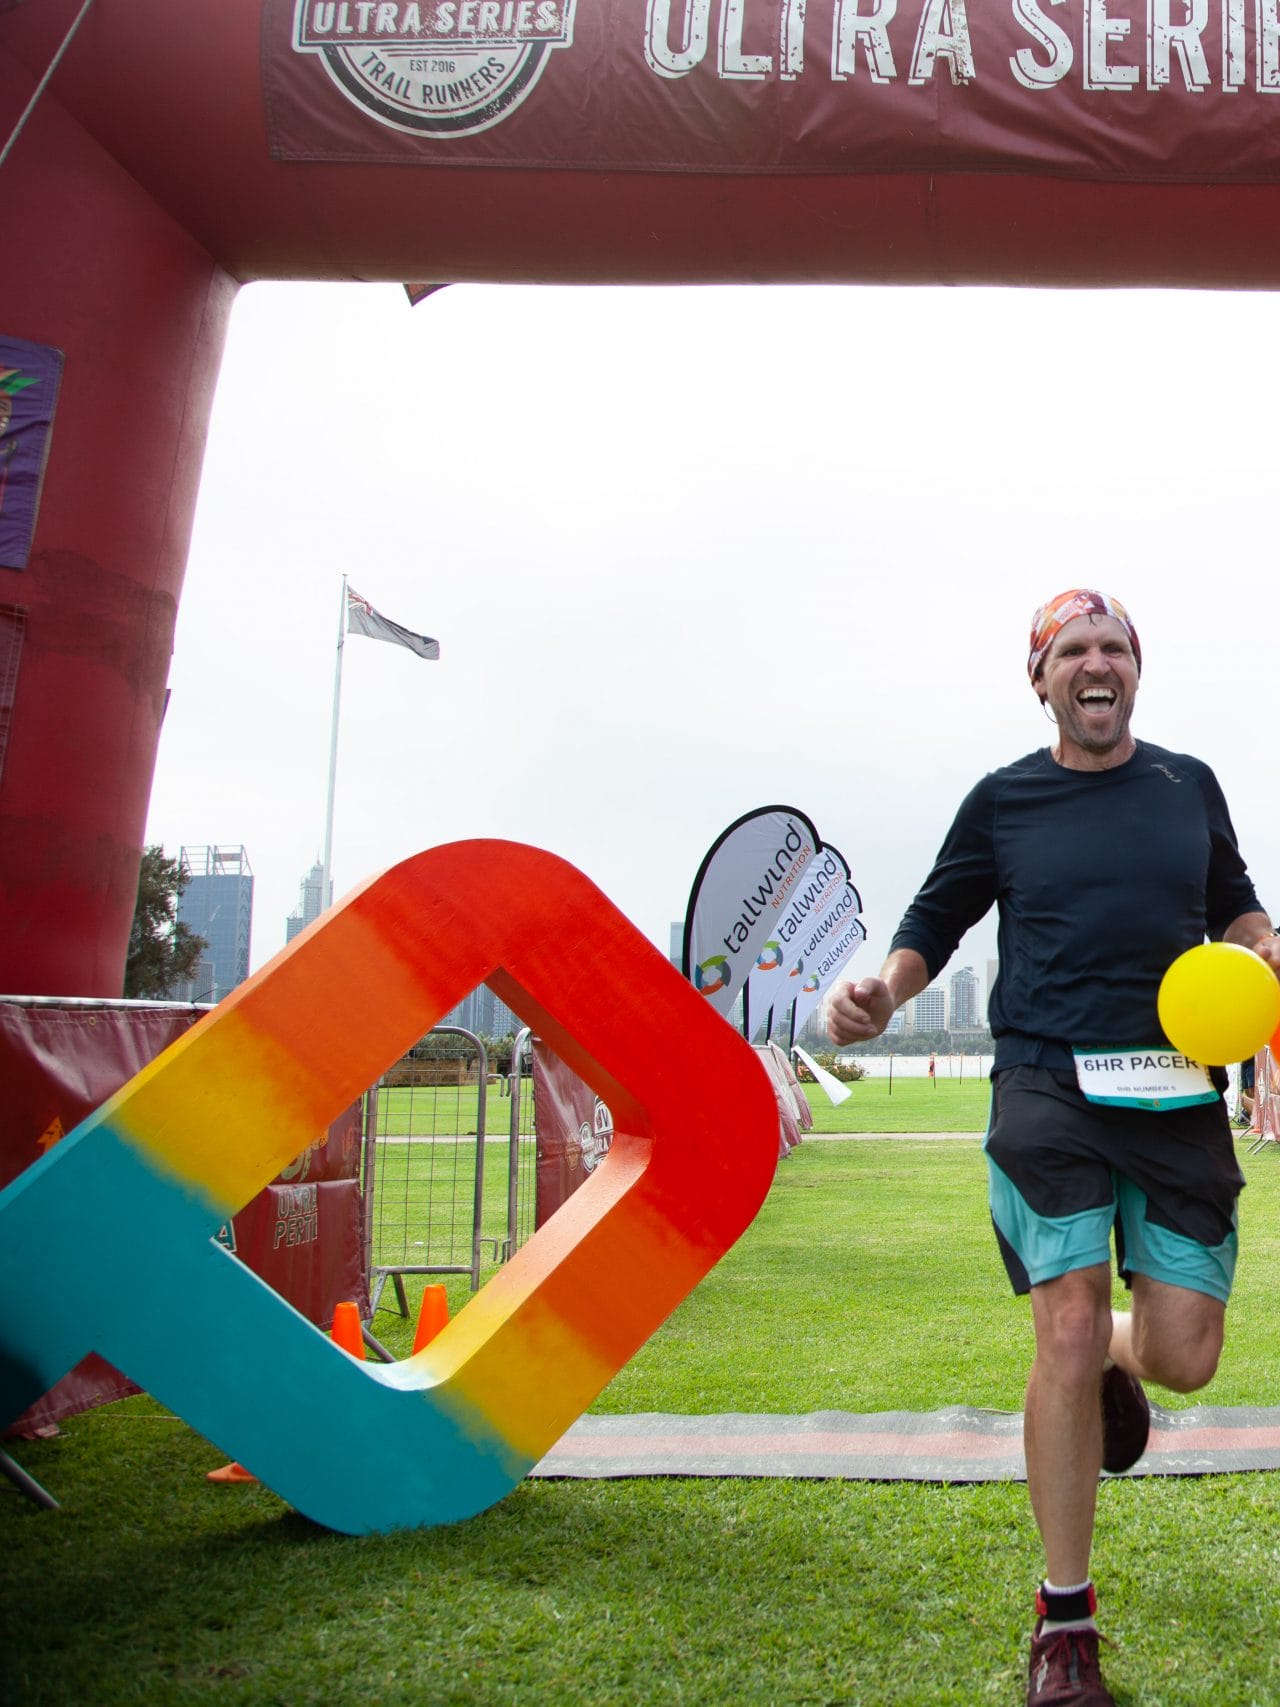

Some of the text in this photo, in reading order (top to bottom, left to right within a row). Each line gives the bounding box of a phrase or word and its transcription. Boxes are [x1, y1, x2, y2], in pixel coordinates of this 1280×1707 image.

[313, 1, 560, 34] ULTRA SERIES
[361, 51, 506, 105] TRAIL RUNNERS
[409, 60, 456, 73] EST 2016
[771, 844, 812, 910] NUTRITION
[813, 871, 845, 916] NUTRITION
[1083, 1055, 1200, 1072] 6HR PACER
